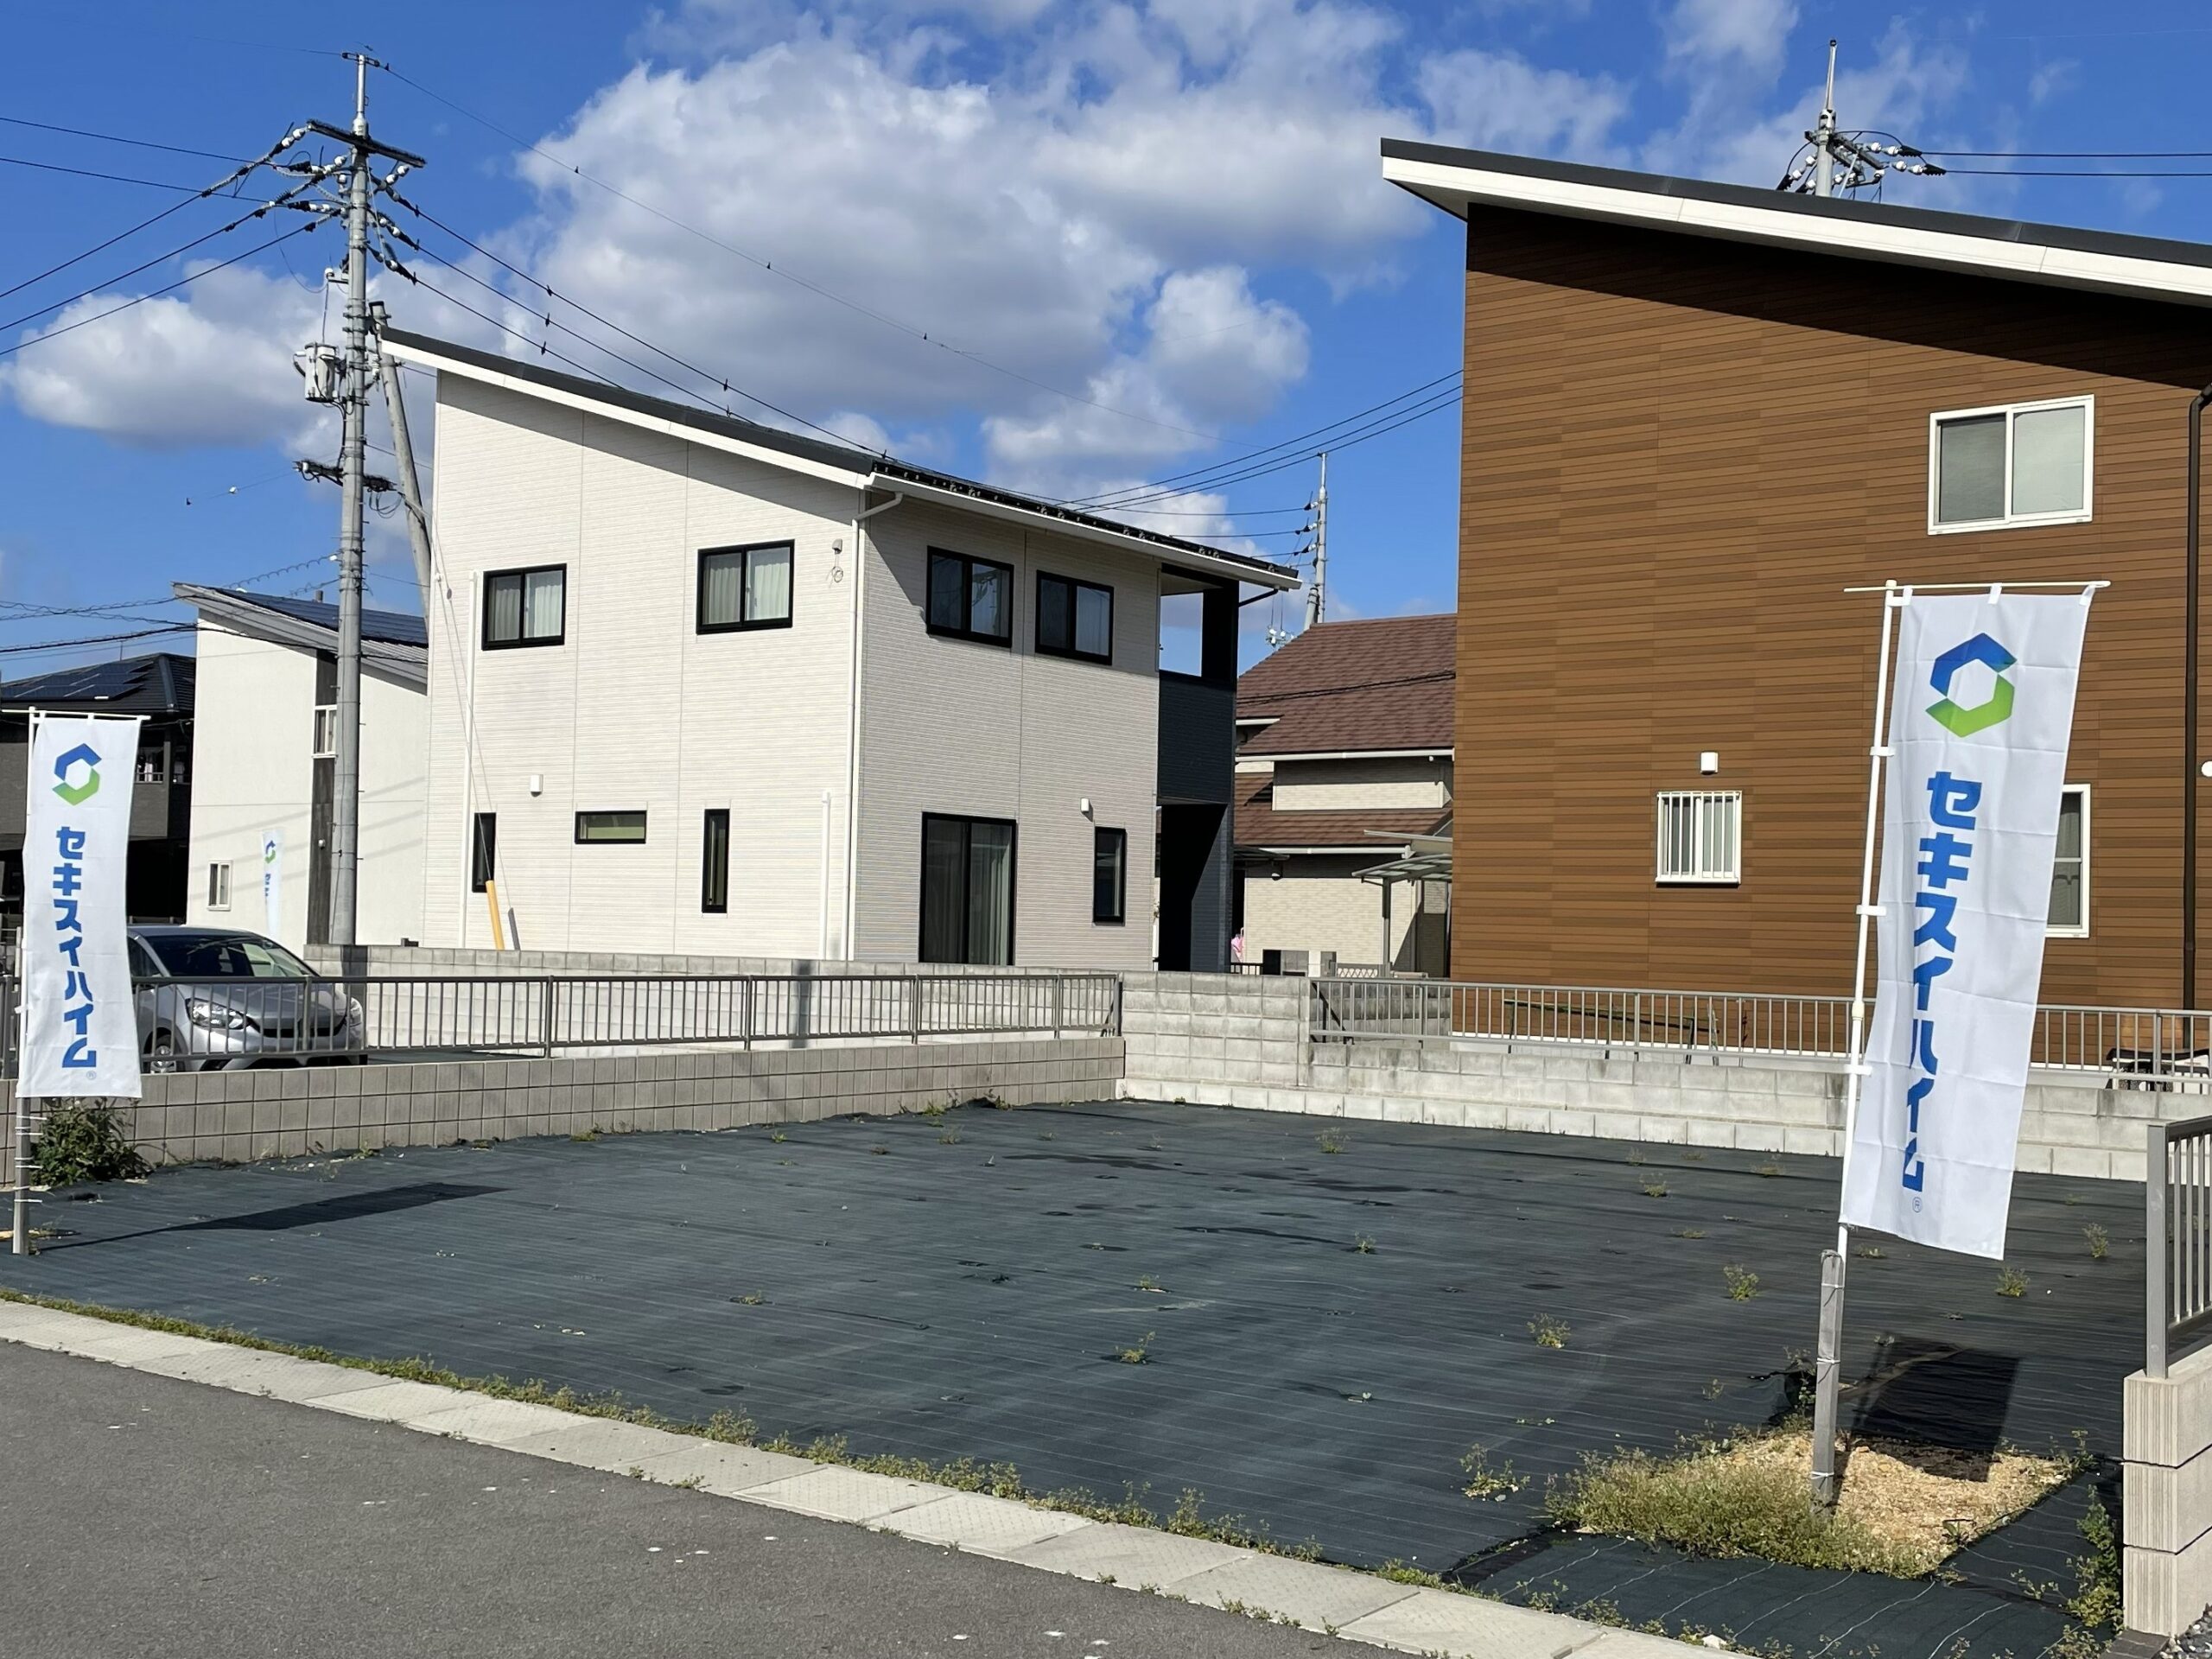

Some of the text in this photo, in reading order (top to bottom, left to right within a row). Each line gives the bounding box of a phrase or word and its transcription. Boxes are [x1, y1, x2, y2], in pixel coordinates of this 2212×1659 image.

[53, 826, 97, 1068] セキスイハイム
[1902, 771, 1982, 1192] セキスイハイム
